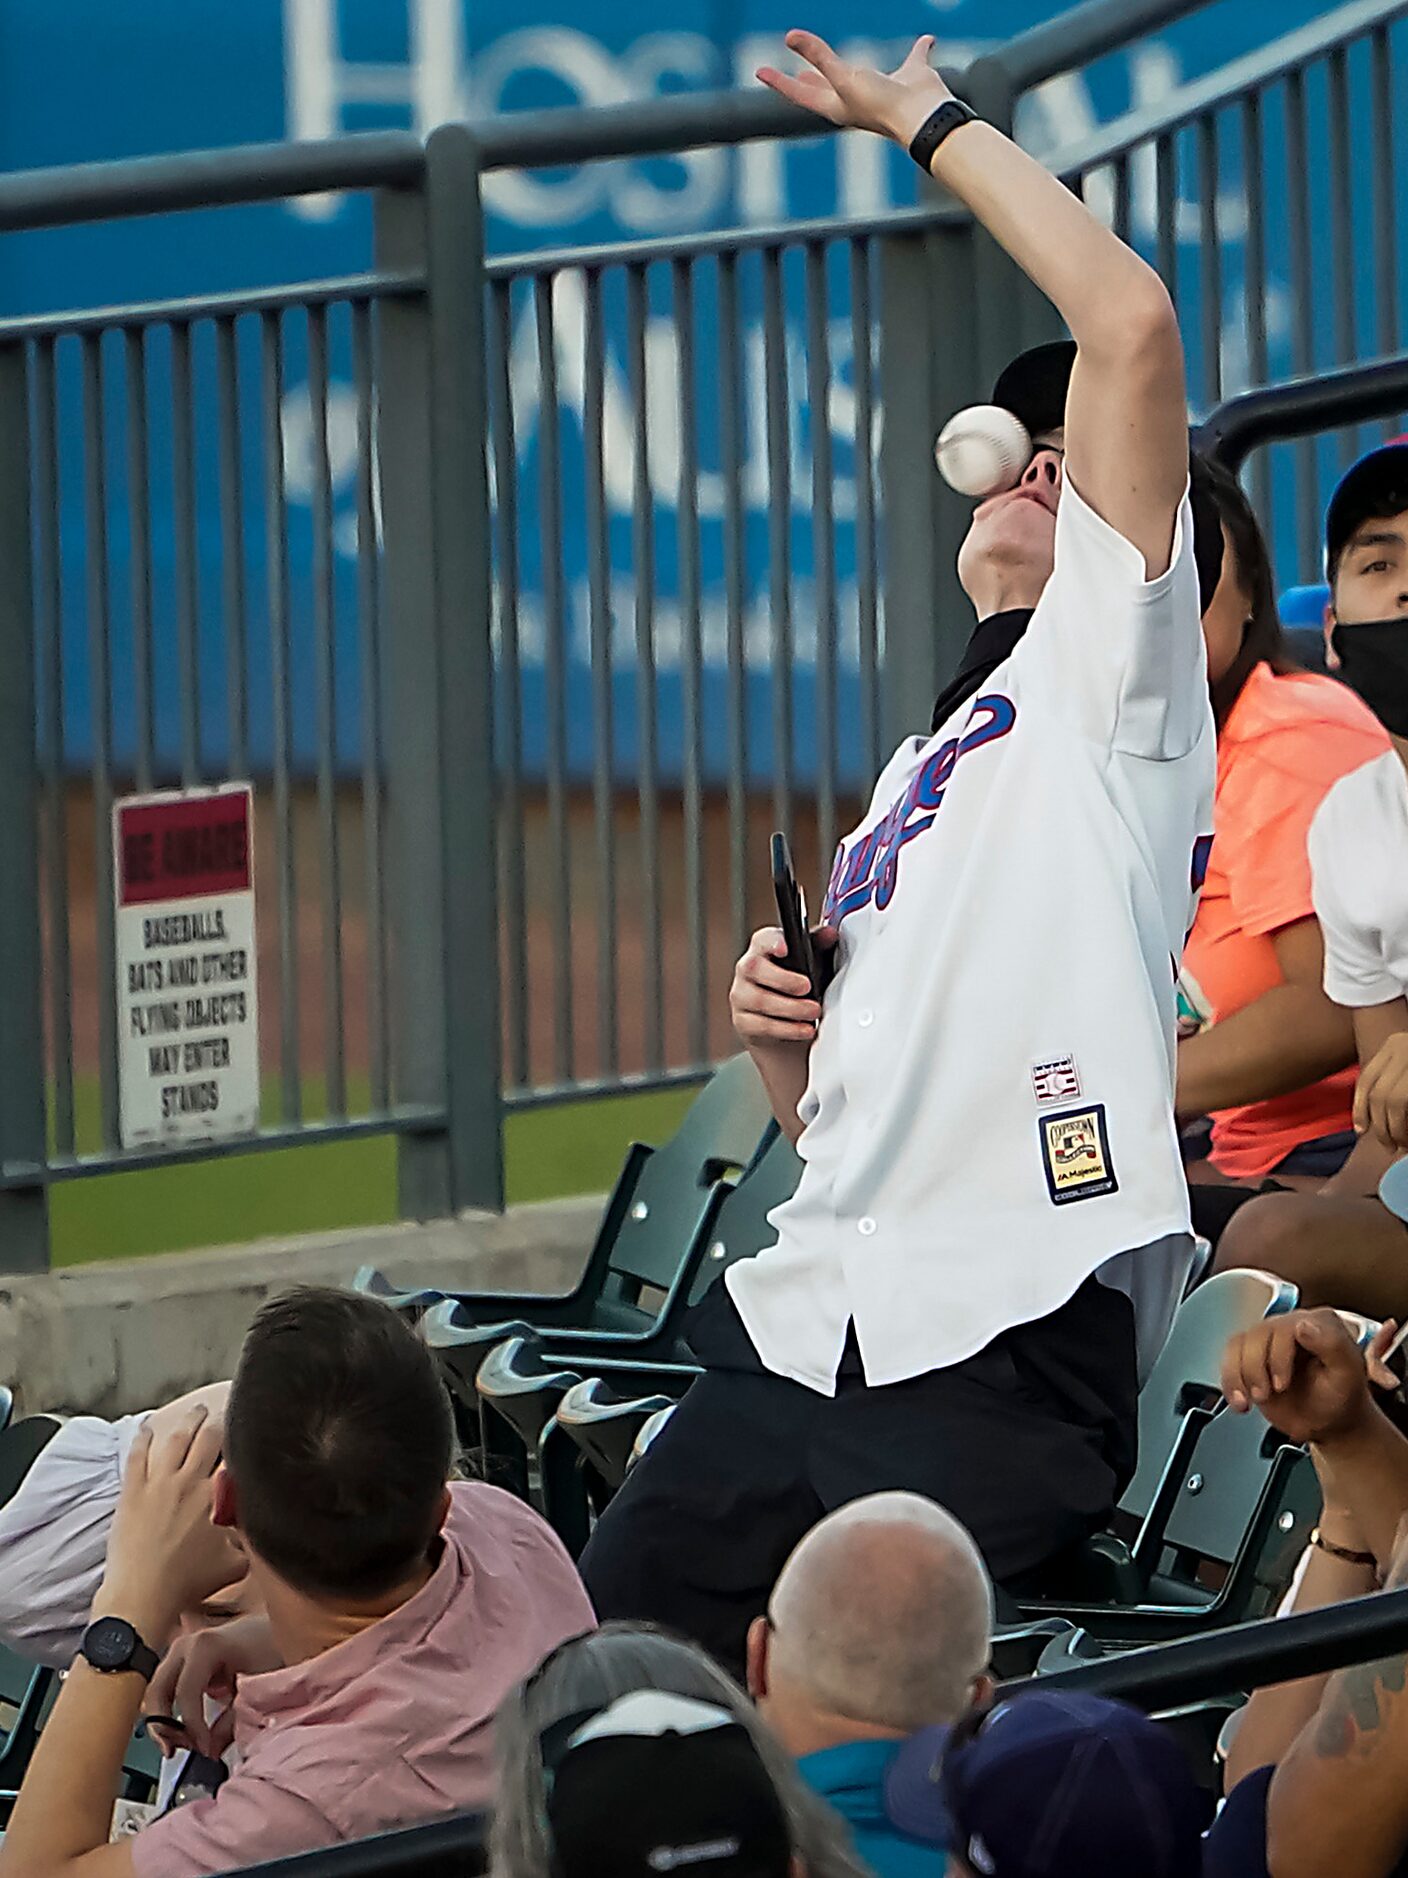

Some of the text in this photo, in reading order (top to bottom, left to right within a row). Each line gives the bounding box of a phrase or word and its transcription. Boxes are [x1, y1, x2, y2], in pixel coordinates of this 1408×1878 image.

[123, 832, 154, 884] BE
[129, 950, 247, 993] BATS AND OTHER
[131, 991, 246, 1037] FLYING OBJECTS
[150, 1037, 230, 1076] MAY ENTER
[162, 1080, 219, 1118] STANDS
